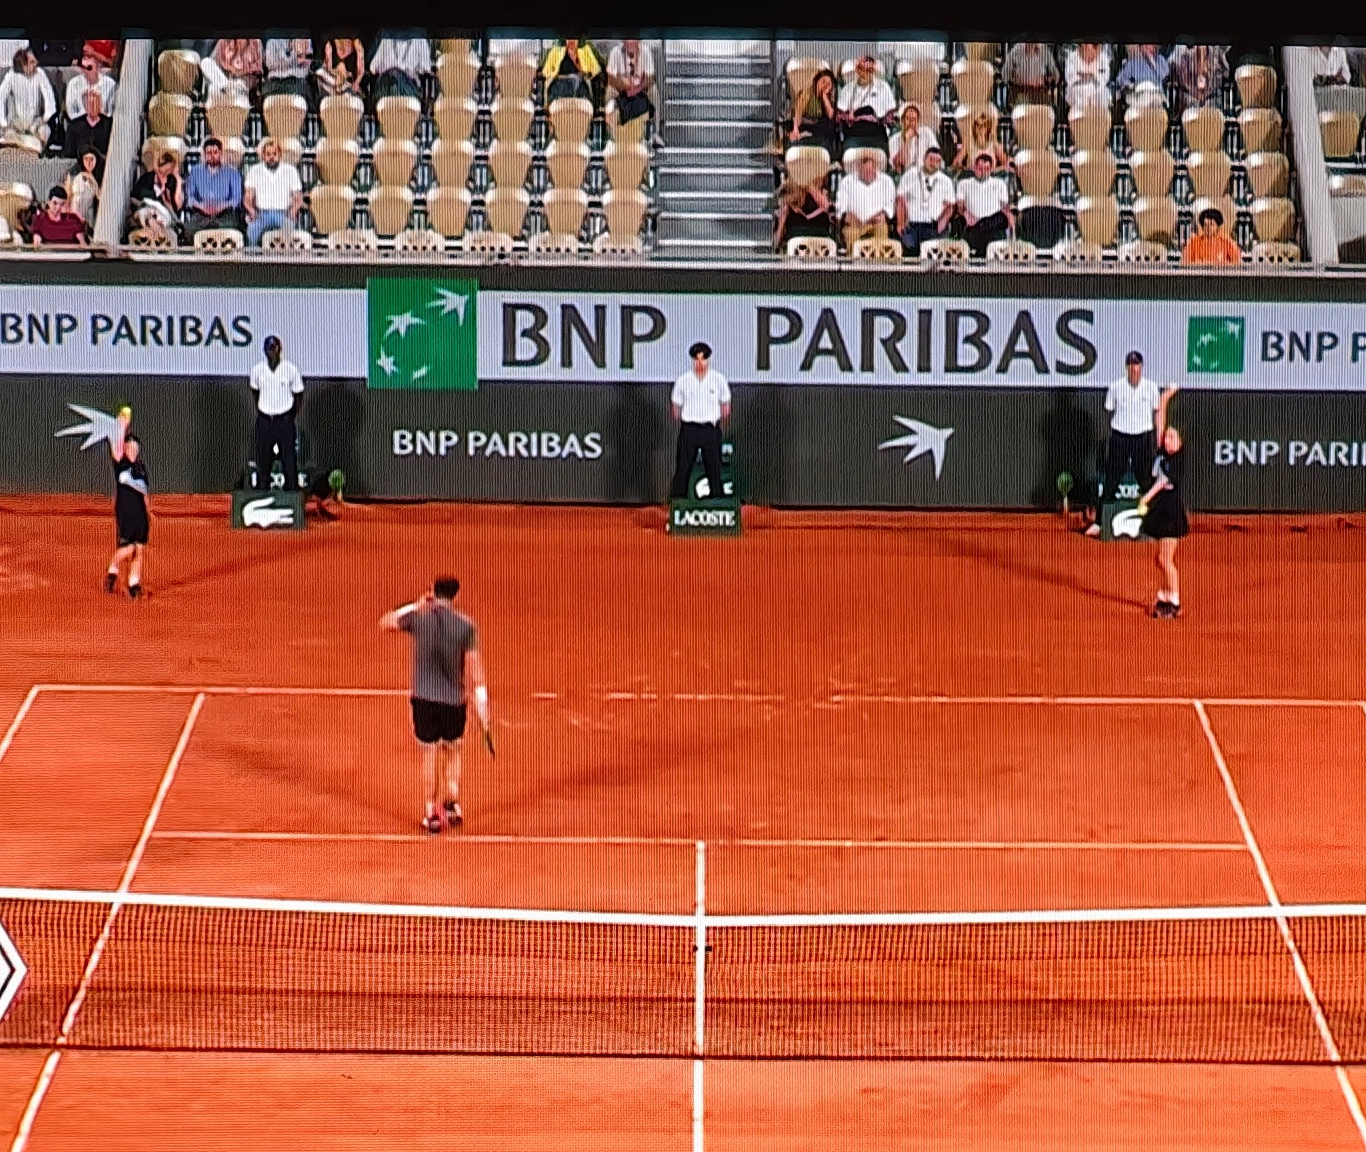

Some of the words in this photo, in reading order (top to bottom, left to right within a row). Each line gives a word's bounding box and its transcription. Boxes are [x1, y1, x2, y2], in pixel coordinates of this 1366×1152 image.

[0, 314, 78, 346] BNP
[90, 314, 253, 348] PARIBAS
[502, 302, 667, 370] BNP
[756, 306, 1098, 375] PARIBAS
[1260, 331, 1339, 364] BNP
[392, 428, 457, 458] BNP
[467, 430, 603, 460] PARIBAS
[1214, 439, 1280, 467] BNP
[673, 510, 735, 526] LACOSTE
